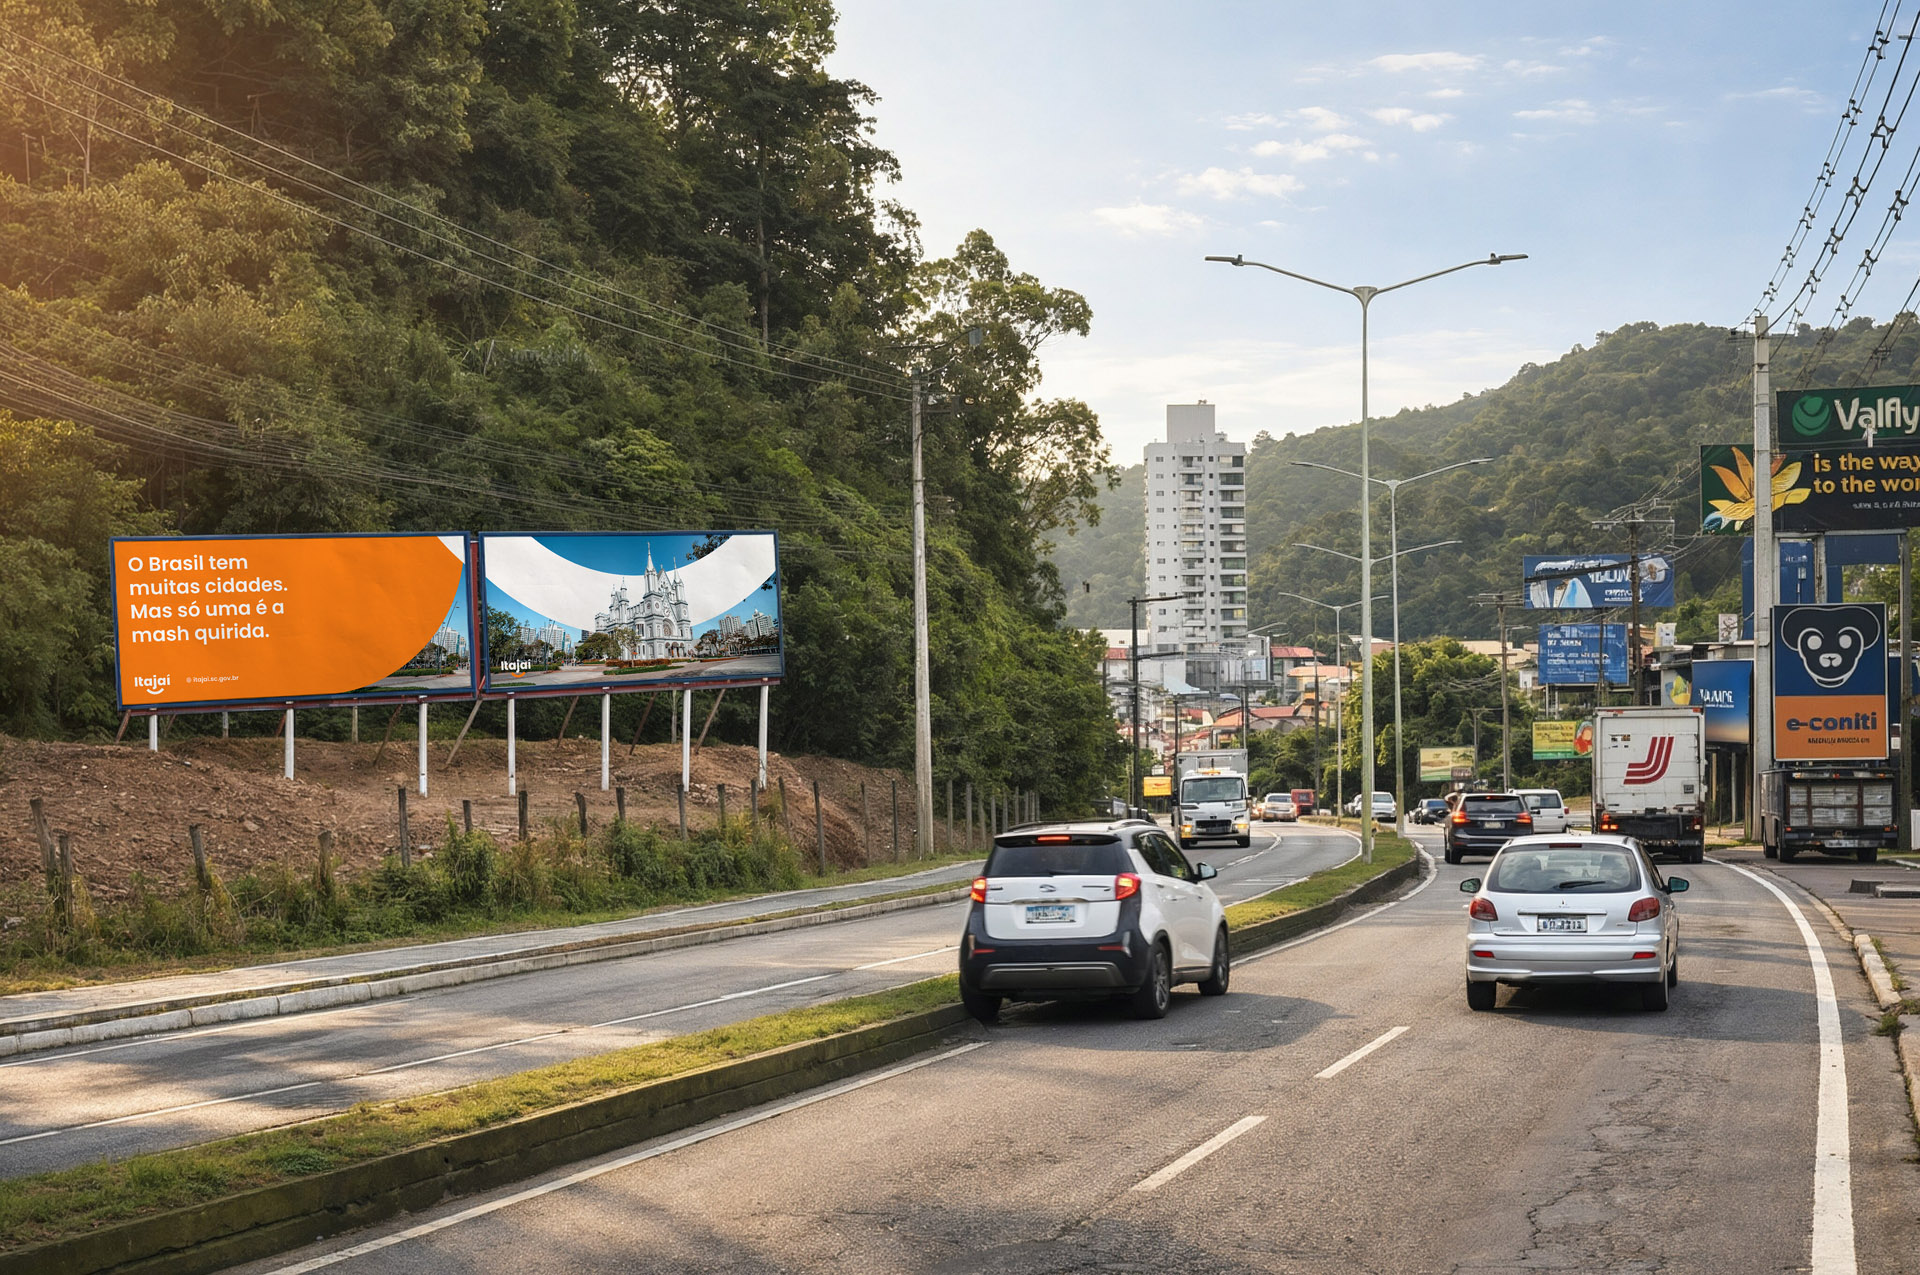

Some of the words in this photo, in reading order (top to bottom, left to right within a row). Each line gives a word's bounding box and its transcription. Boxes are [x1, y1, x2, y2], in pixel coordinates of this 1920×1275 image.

[1814, 453, 1832, 473] is
[1839, 452, 1874, 471] the
[1813, 478, 1836, 494] to
[1841, 475, 1876, 493] the
[128, 557, 143, 572] O
[149, 554, 204, 571] Brasil
[208, 556, 248, 570] tem
[129, 578, 200, 596] muitas
[205, 577, 288, 593] cidades.
[131, 604, 173, 619] Mas
[177, 600, 200, 617] só
[205, 603, 251, 616] uma
[256, 598, 267, 615] é
[272, 602, 284, 614] a
[132, 625, 189, 643] mash
[194, 623, 270, 645] quirida.
[134, 674, 171, 690] Itajaí
[1786, 712, 1877, 731] e-coniti
